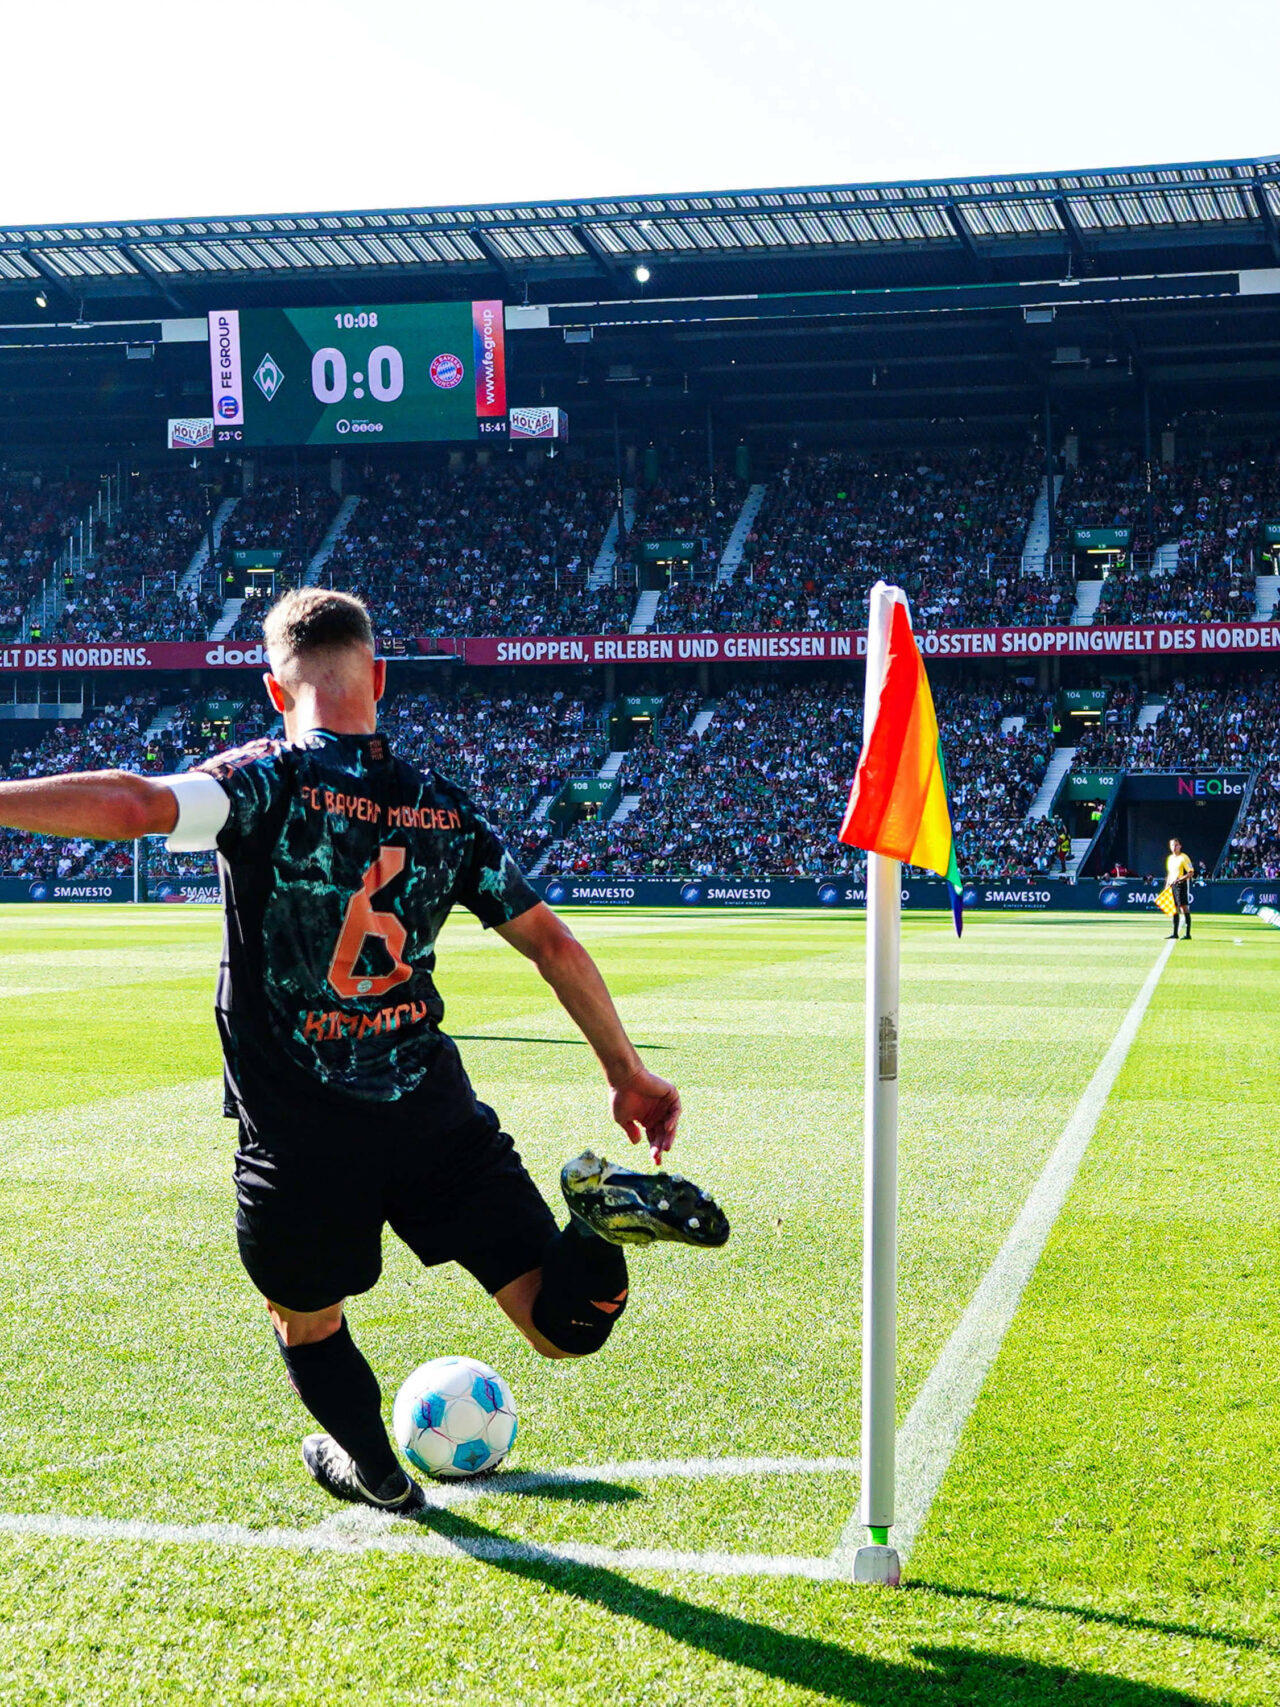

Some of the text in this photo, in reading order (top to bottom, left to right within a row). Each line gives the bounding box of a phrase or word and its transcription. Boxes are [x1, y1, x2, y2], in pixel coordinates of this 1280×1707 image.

[334, 312, 378, 328] 10:08
[218, 316, 232, 388] FE GROUP
[482, 309, 497, 405] www.fe.group
[311, 345, 404, 404] 0:0
[218, 431, 242, 441] 23°C
[480, 423, 506, 432] 15:41
[497, 641, 590, 663] SHOPPEN,
[594, 639, 673, 660] ERLEBEN
[678, 638, 719, 658] UND
[724, 637, 826, 657] GENIESSEN
[830, 636, 851, 656] IN
[913, 627, 1280, 655] RÖSSTEN SHOPPINGWELT DES NORDEN
[24, 648, 57, 667] DES
[62, 647, 152, 666] NORDENS.
[205, 645, 271, 665] dod
[1072, 776, 1114, 785] 104 102
[53, 886, 112, 897] SMAVESTO
[572, 888, 635, 898] SMAVESTO
[707, 888, 771, 899] SMAVESTO
[985, 891, 1051, 902] SMAVESTO
[328, 846, 413, 999] 6
